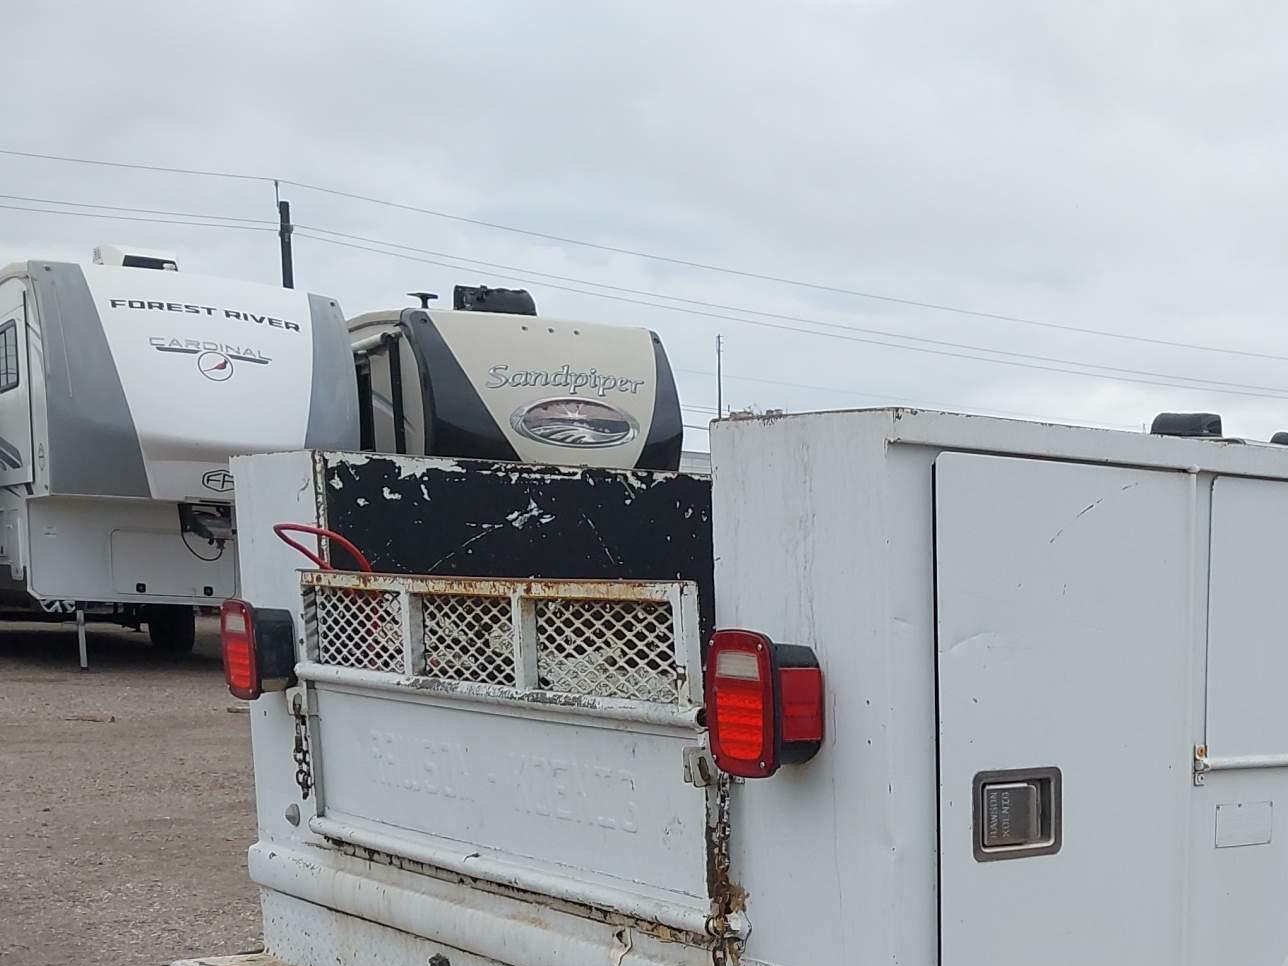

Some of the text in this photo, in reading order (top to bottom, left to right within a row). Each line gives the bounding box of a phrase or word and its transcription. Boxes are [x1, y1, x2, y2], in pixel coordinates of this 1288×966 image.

[110, 299, 302, 333] FOREST RIVER
[149, 336, 273, 361] CARDINAL
[486, 364, 645, 397] Sandpiper
